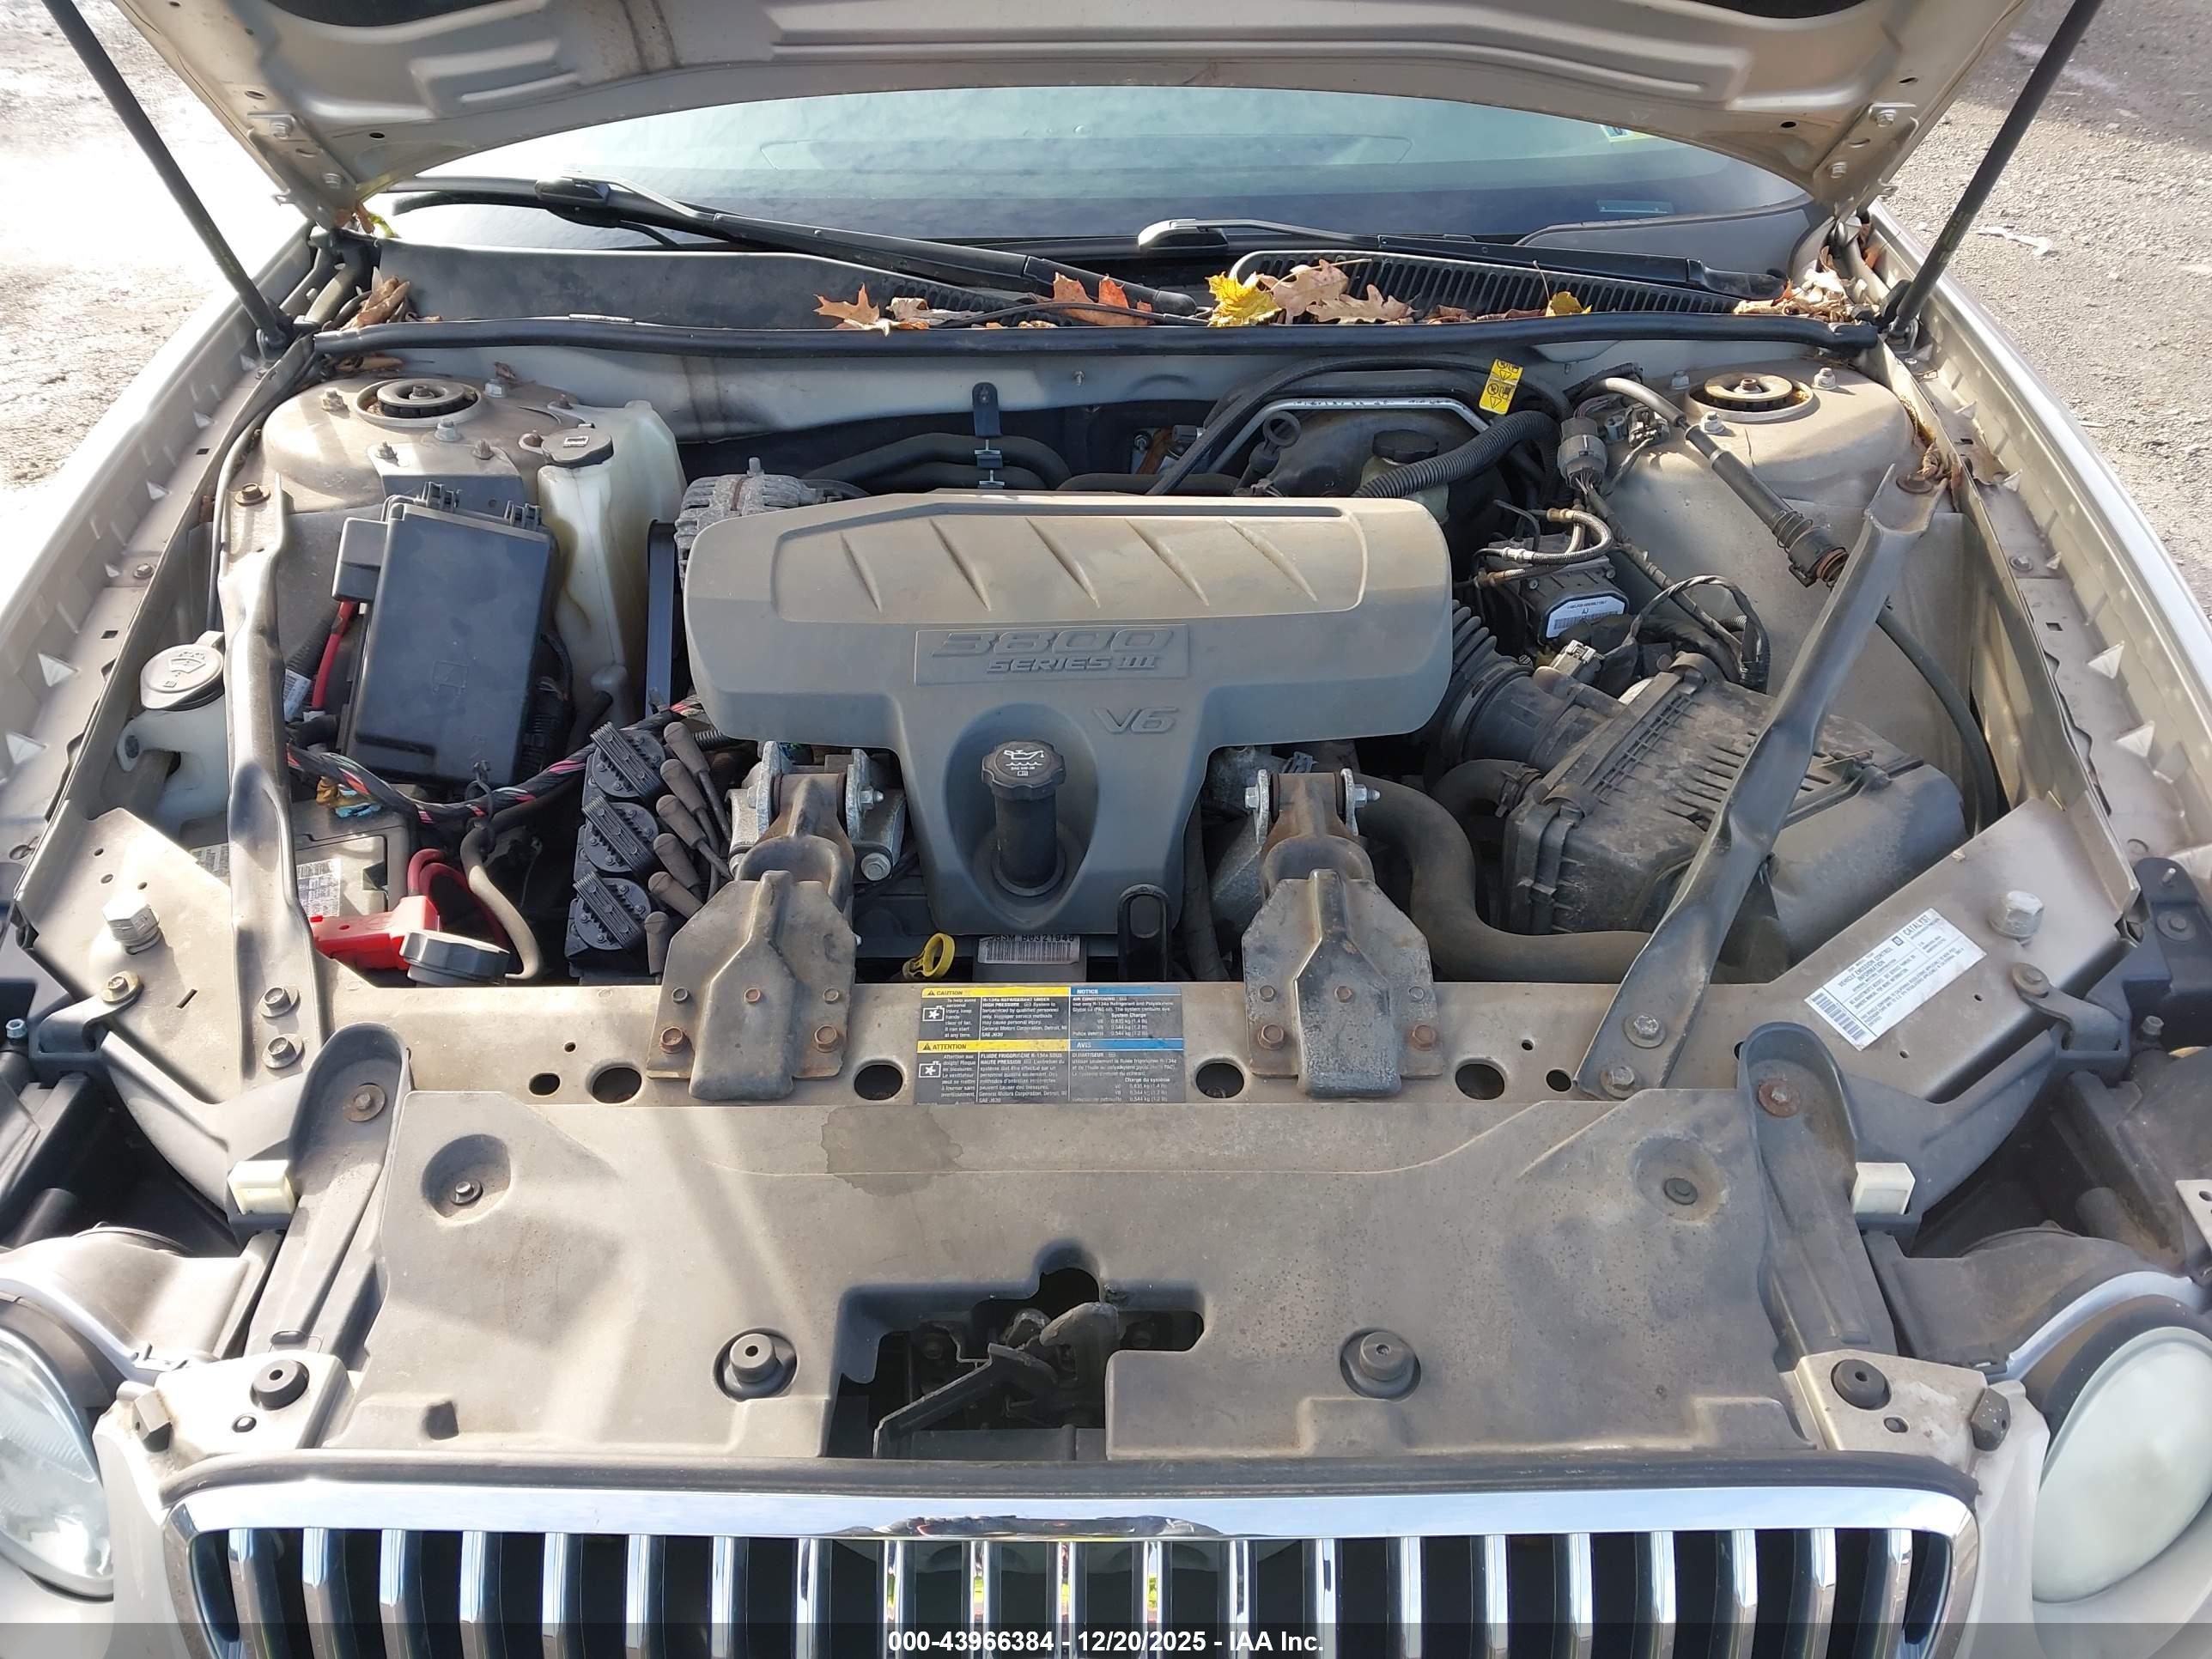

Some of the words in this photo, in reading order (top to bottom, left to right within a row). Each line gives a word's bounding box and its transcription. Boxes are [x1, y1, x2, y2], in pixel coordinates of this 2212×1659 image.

[932, 628, 1175, 659] 3800
[987, 655, 1114, 674] SERIES
[1094, 707, 1177, 735] V6
[1901, 914, 1931, 936] CATALYST
[1872, 945, 1893, 961] CONTROL
